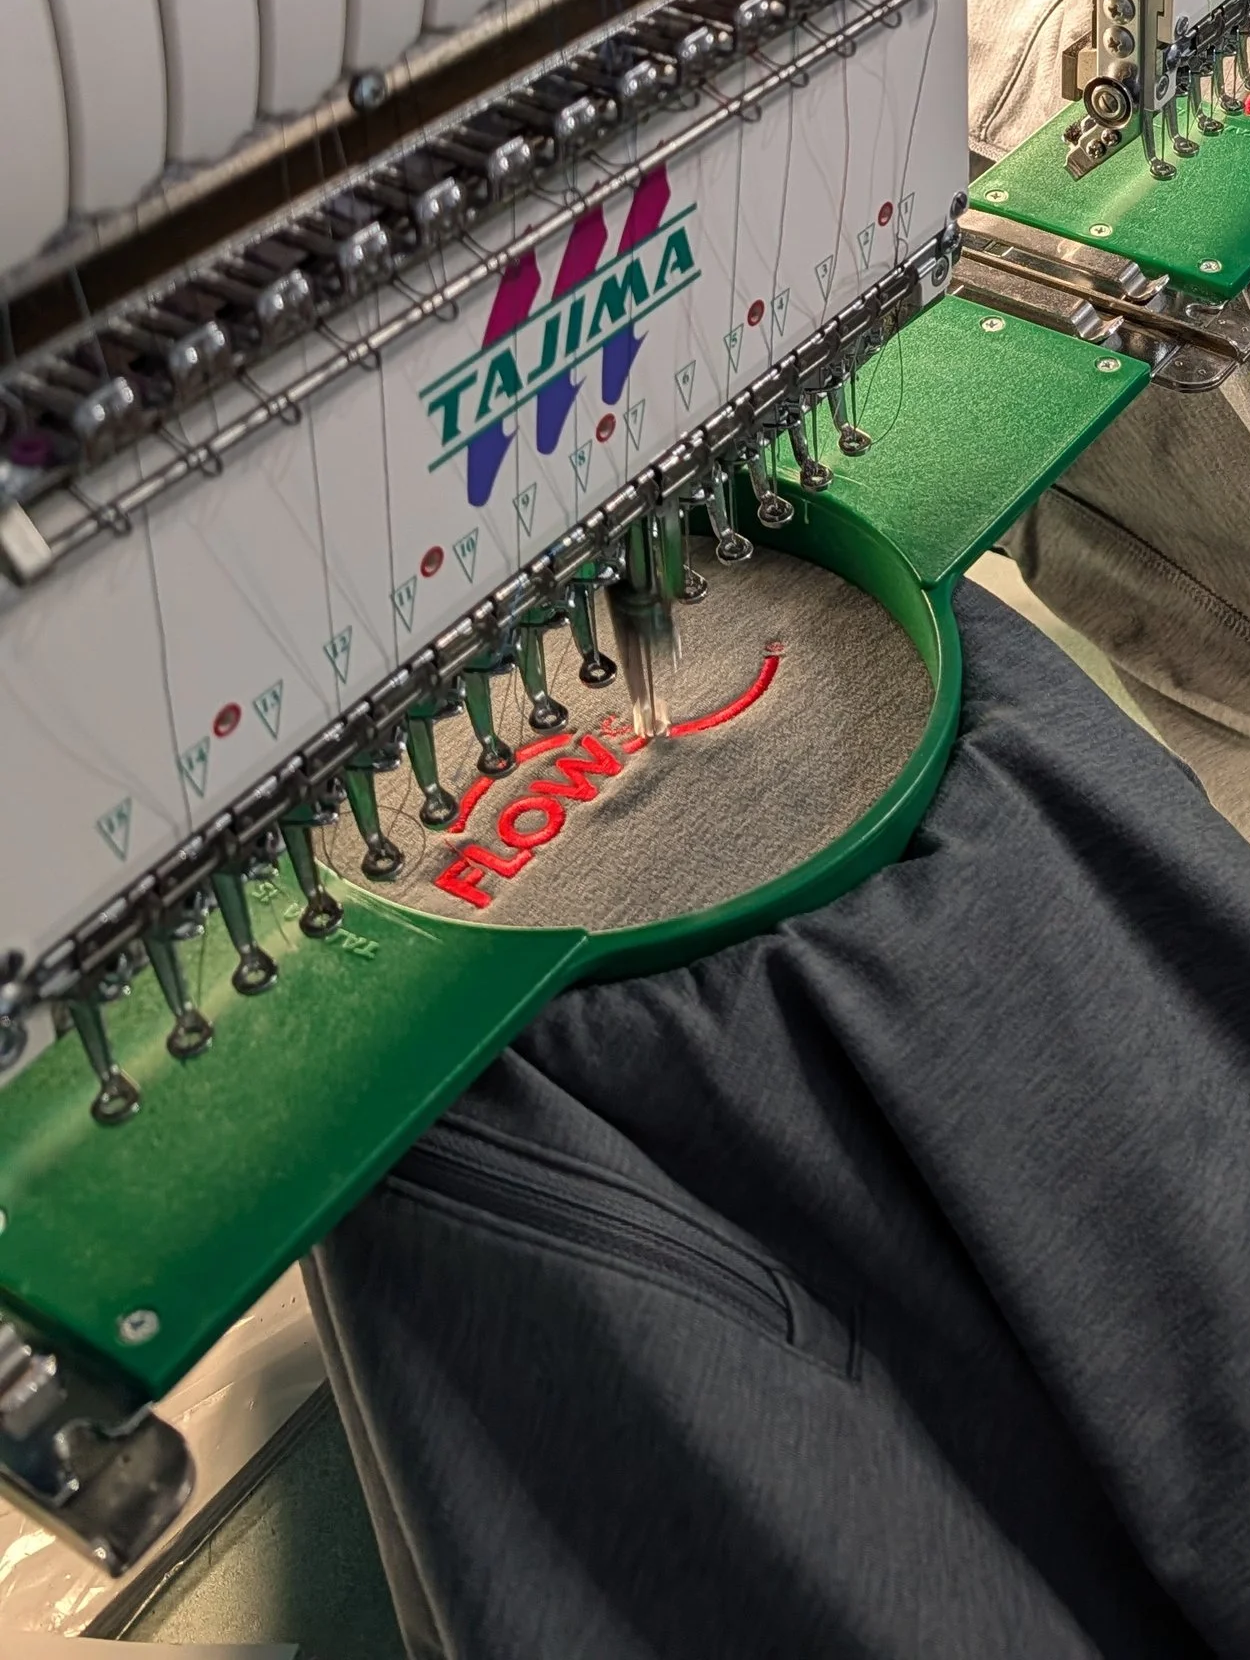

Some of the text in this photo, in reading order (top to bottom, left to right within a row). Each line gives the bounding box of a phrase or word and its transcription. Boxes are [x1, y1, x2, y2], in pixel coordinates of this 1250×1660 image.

[427, 225, 694, 447] TAJIMA
[729, 332, 738, 348] 5
[682, 371, 690, 385] 6
[577, 450, 586, 466] 8
[521, 493, 530, 510] 9
[460, 536, 475, 558] 10
[397, 586, 412, 607] 11
[331, 635, 349, 659] 12
[186, 747, 207, 772] 14
[433, 734, 624, 910] FLOW
